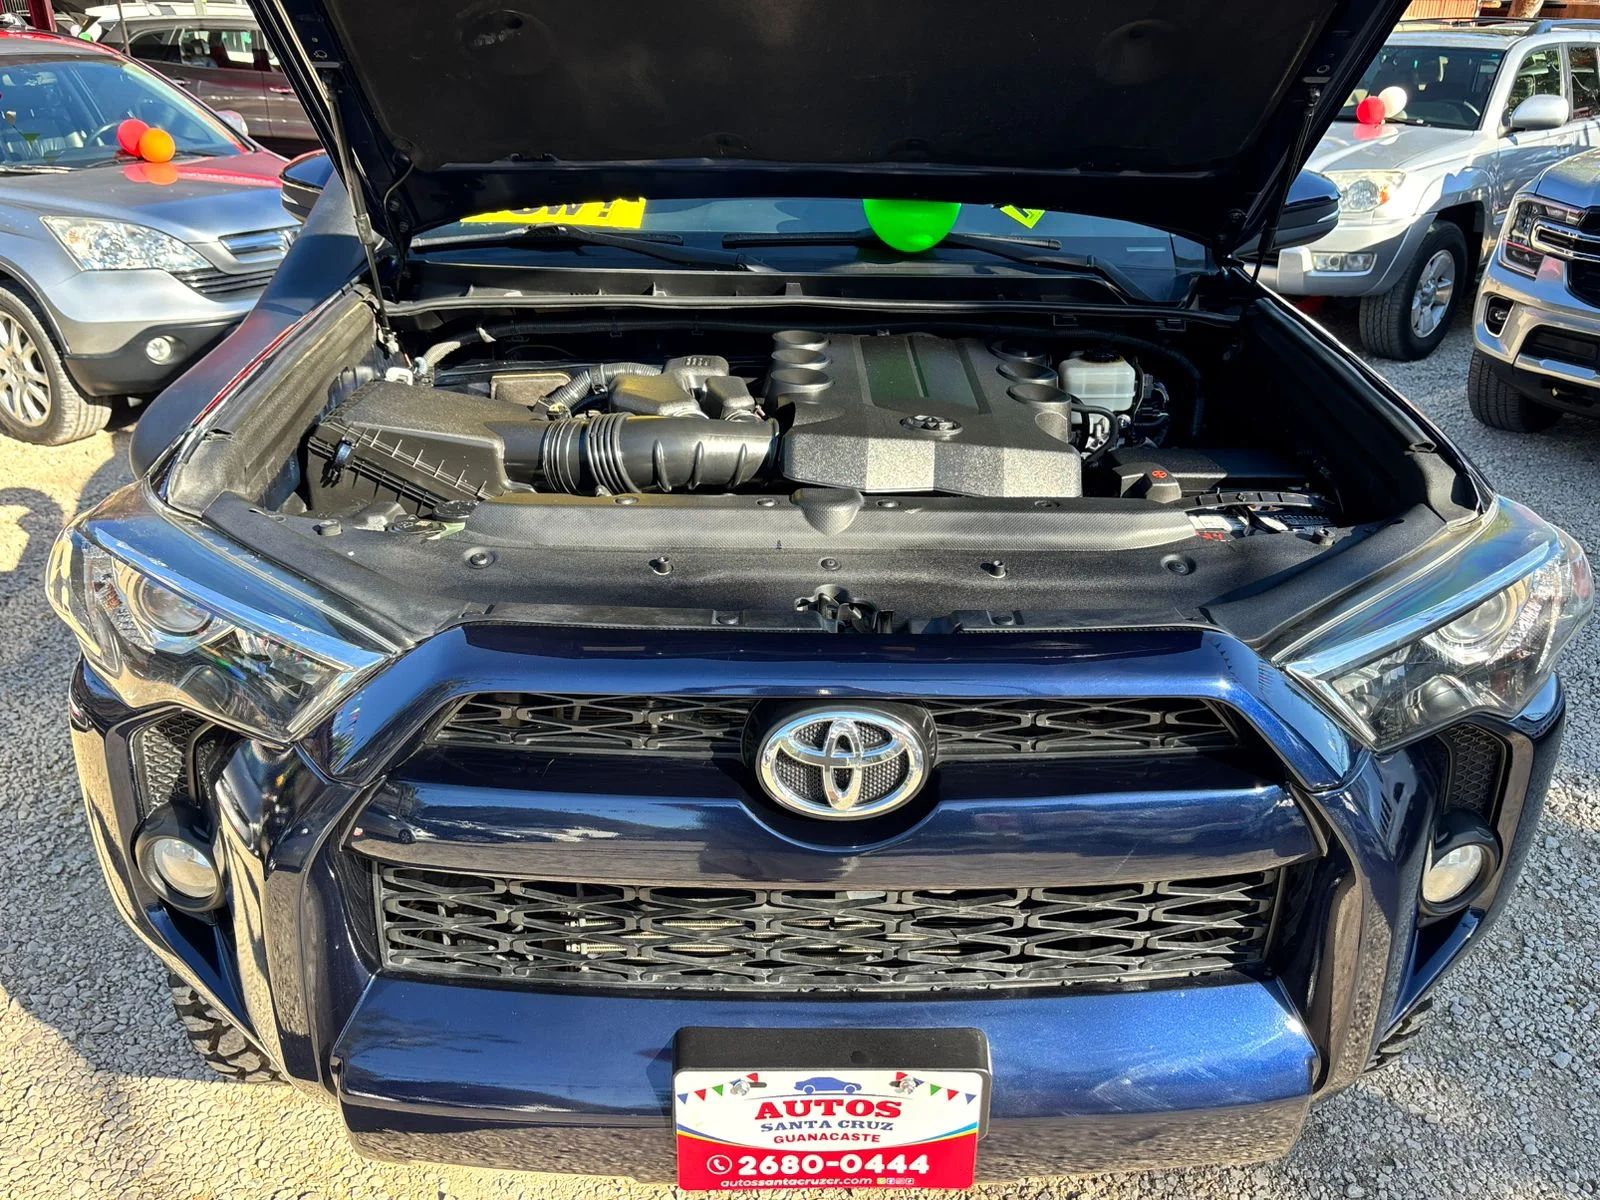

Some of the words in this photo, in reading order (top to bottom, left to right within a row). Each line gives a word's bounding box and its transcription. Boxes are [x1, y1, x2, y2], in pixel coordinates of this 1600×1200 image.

[755, 1099, 902, 1120] AUTOS
[761, 1120, 832, 1132] SANTA
[838, 1120, 894, 1131] CRUZ
[773, 1133, 881, 1144] GUANACASTE
[738, 1154, 930, 1175] 2680-0444
[720, 1177, 873, 1187] autossantacruzcr.com
